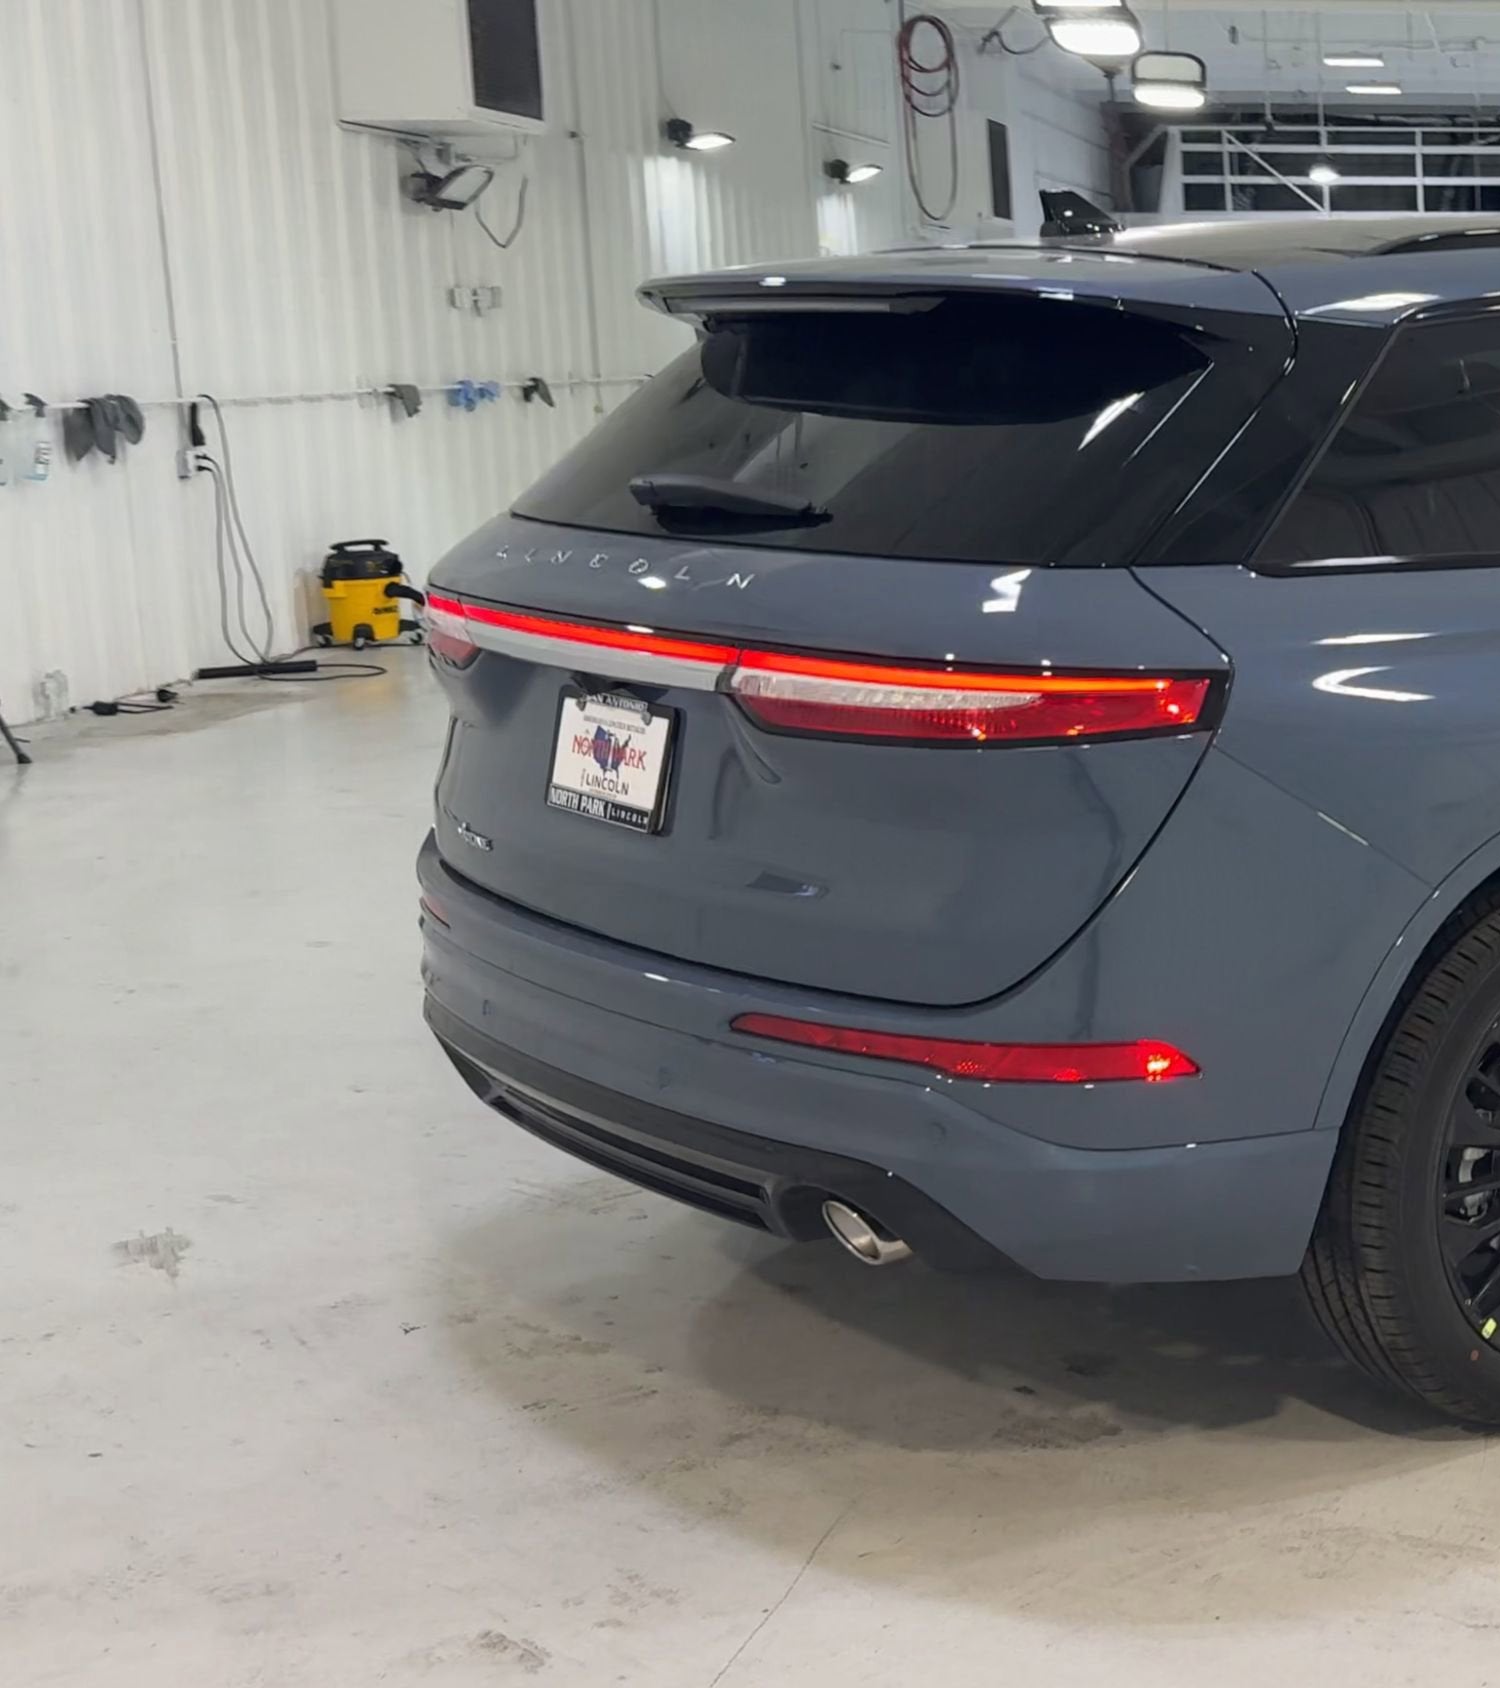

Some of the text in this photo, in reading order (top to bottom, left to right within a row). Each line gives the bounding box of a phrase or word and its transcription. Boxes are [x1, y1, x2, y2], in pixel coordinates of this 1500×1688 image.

[496, 545, 755, 589] LINCOLN
[572, 734, 647, 771] NORTH PARK
[586, 774, 629, 795] LINCOLN
[551, 787, 580, 810] NORTH
[580, 795, 606, 817] PARK
[611, 807, 649, 825] LINCOLN
